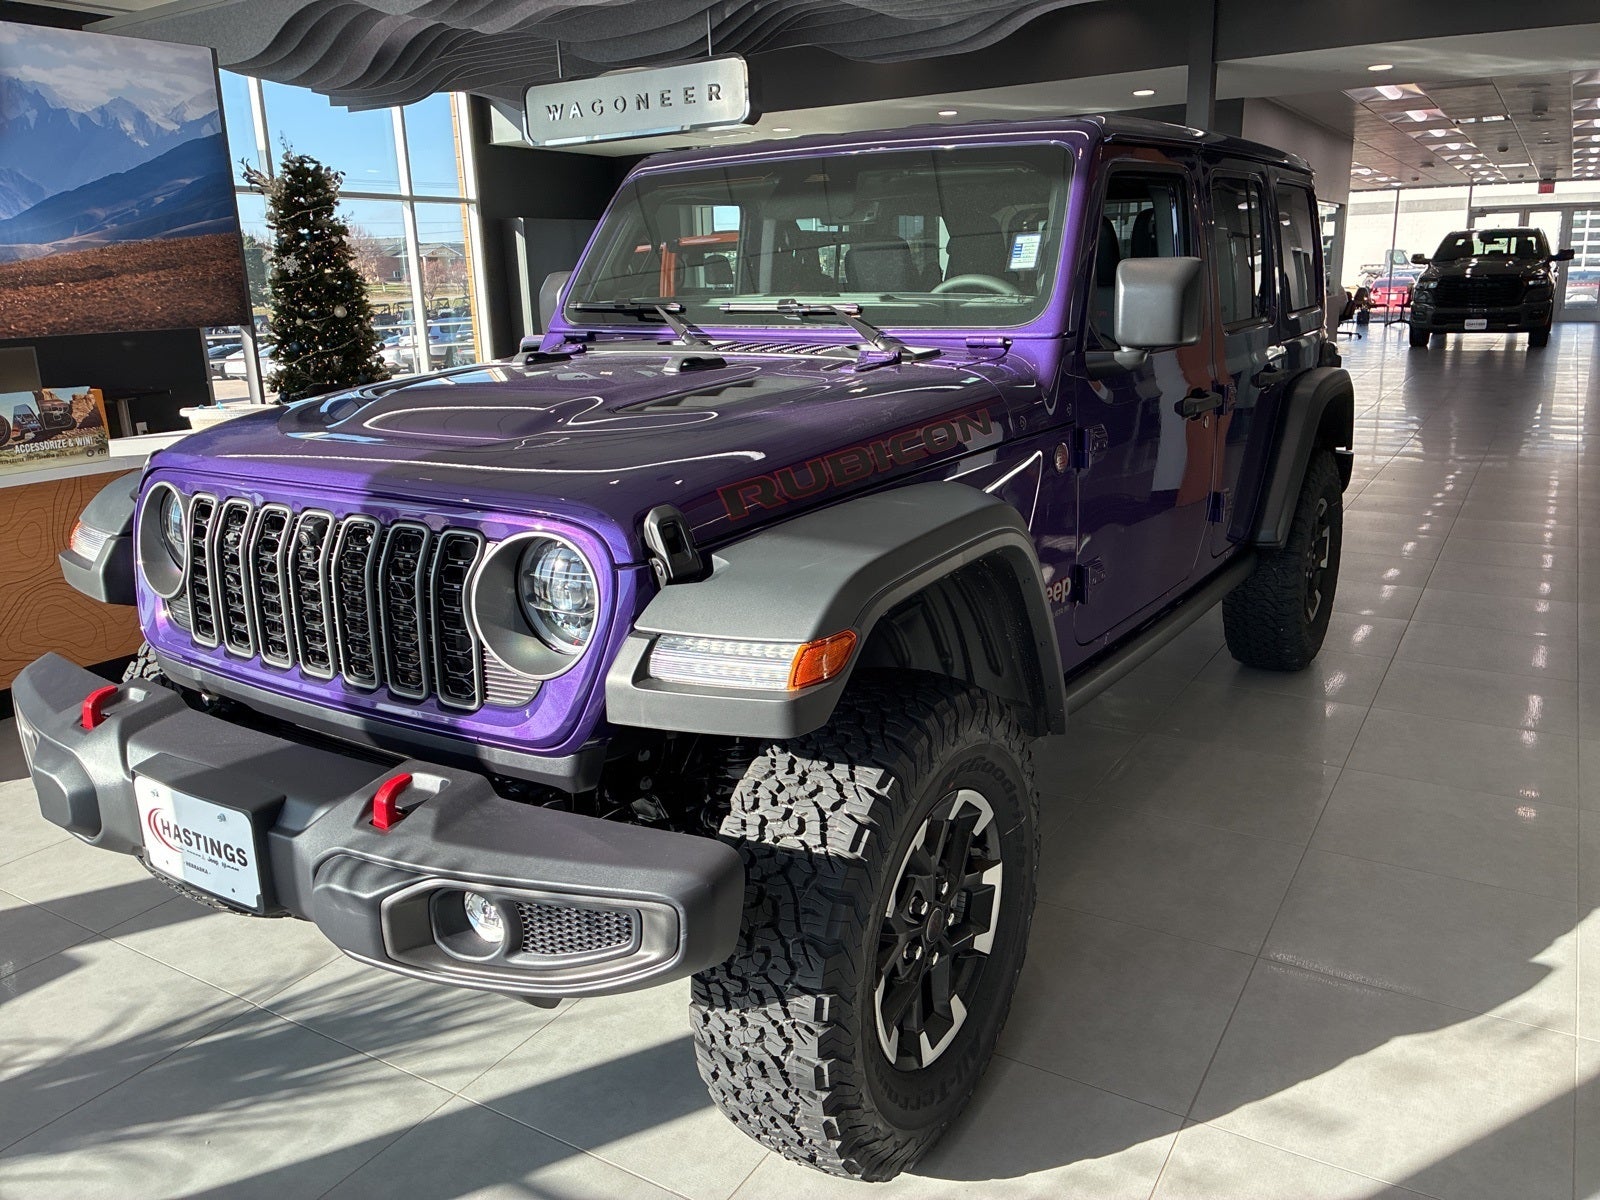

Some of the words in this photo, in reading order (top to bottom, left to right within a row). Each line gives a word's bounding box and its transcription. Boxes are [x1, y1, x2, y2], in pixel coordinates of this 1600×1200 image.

[545, 83, 722, 121] WAGONEER
[15, 440, 68, 454] ACCESSORIZE
[68, 439, 74, 447] &
[76, 436, 93, 446] WIN!
[716, 408, 995, 521] RUBICON
[1046, 576, 1072, 603] eep
[160, 818, 248, 867] HASTINGS
